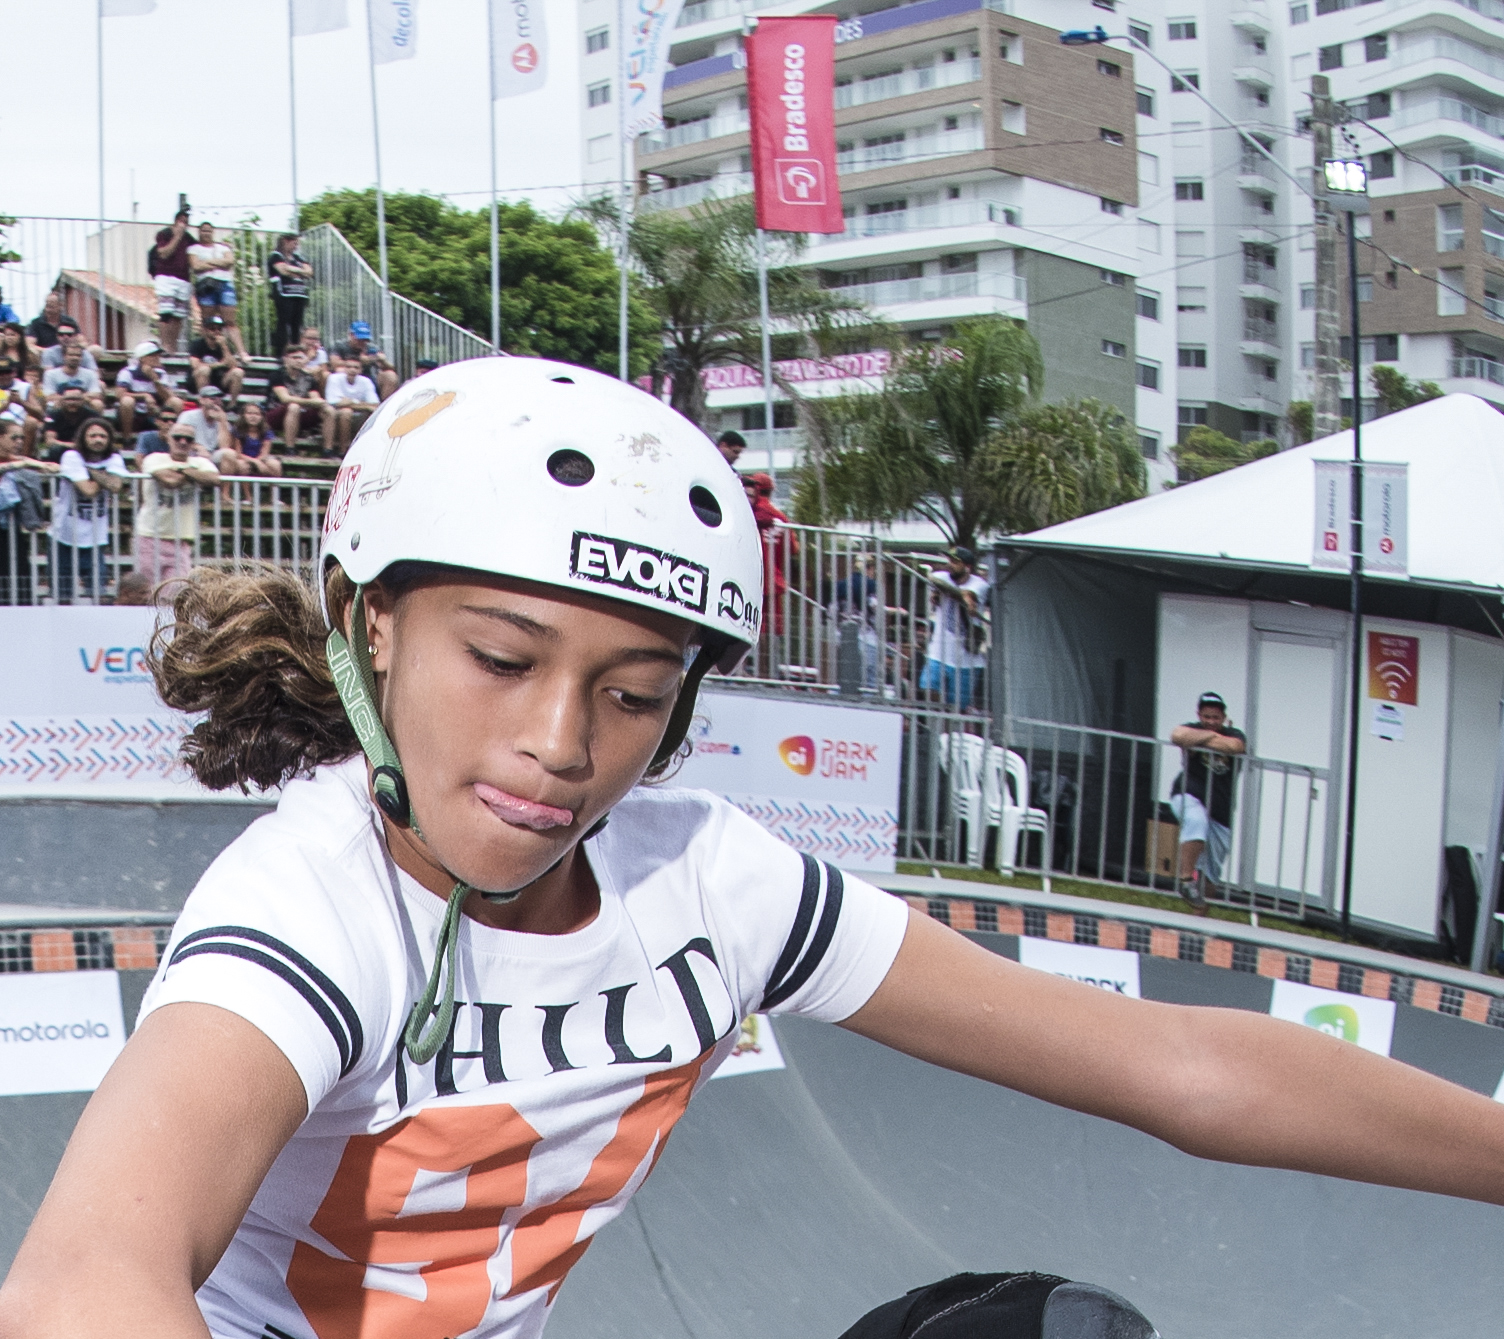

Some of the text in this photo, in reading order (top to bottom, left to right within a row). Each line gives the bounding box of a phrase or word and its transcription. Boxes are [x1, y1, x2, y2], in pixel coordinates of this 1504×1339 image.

[780, 43, 809, 152] Bradesco
[79, 647, 149, 673] VER
[821, 739, 878, 768] PARK
[821, 759, 868, 781] JAM
